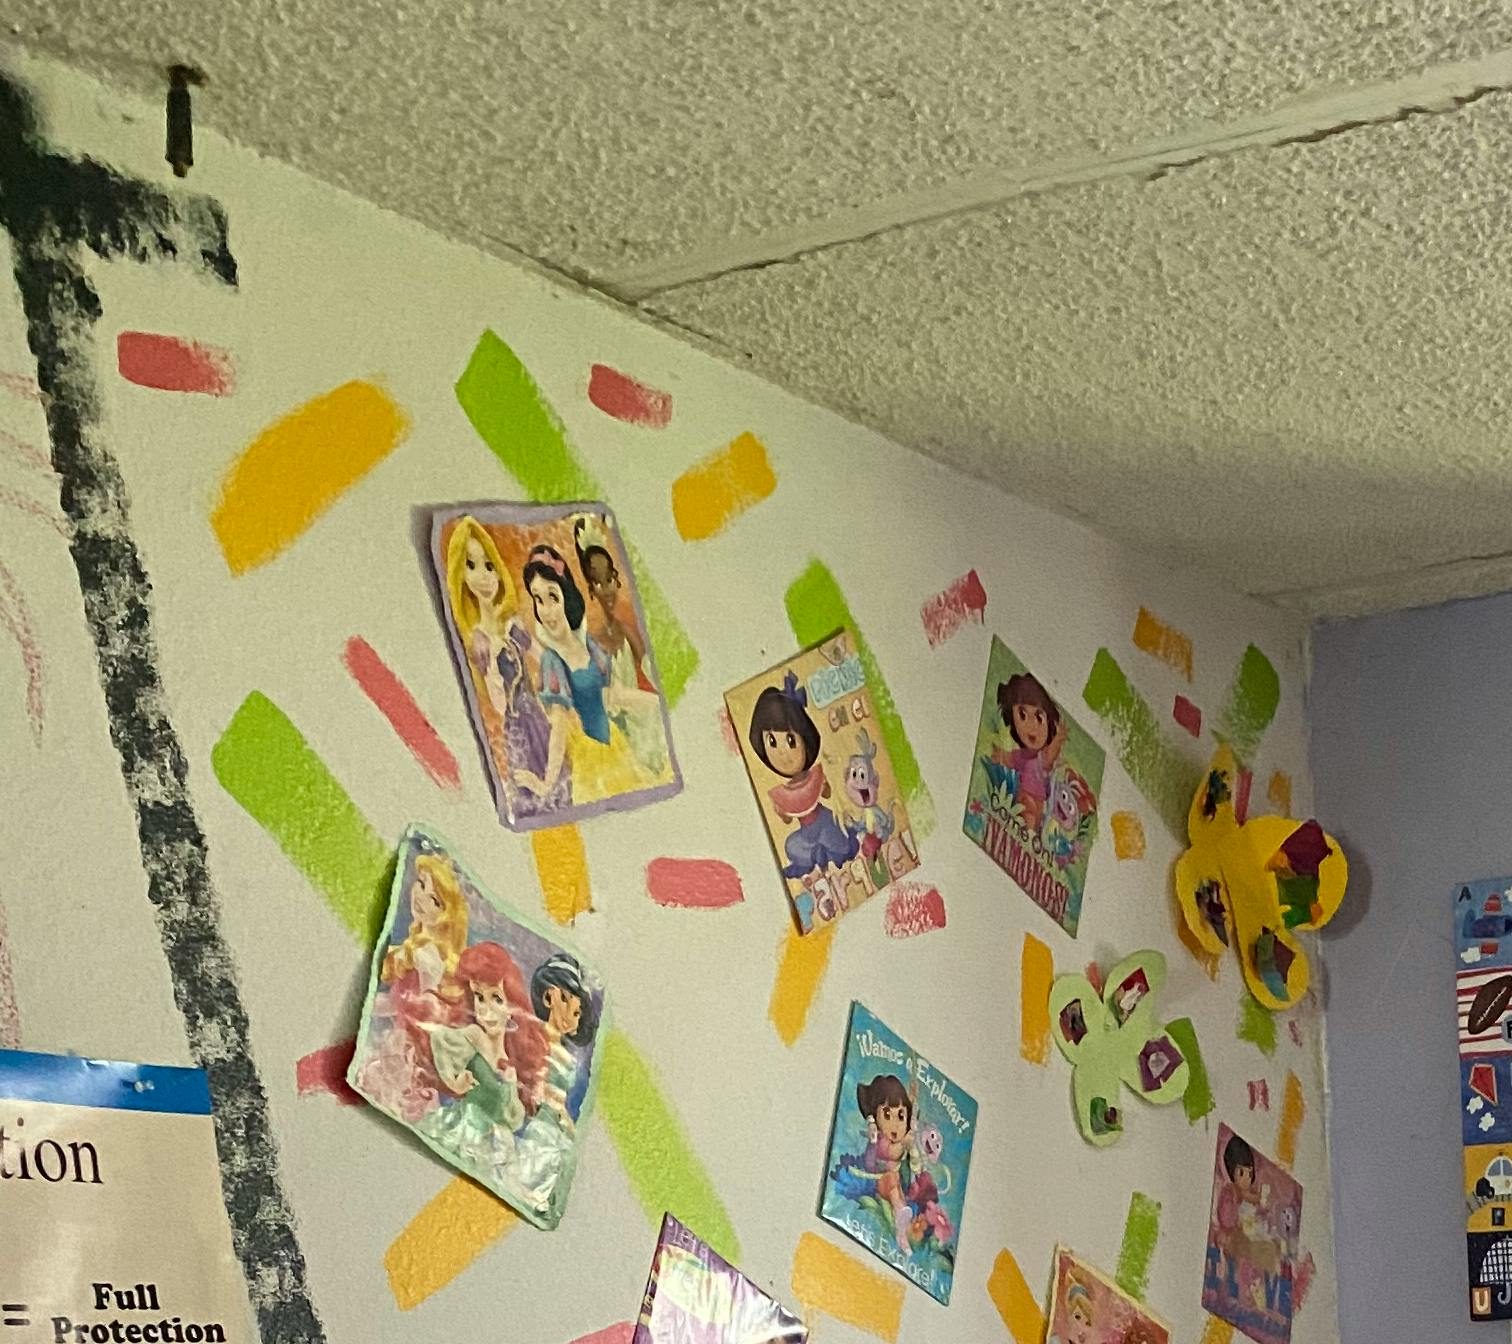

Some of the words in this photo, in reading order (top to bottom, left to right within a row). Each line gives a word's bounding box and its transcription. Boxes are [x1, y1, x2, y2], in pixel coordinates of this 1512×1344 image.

[991, 792, 1029, 842] Come
[1459, 886, 1471, 902] A
[917, 1058, 970, 1133] Explorar!
[880, 1237, 935, 1287] Explore!
[92, 1283, 160, 1310] Full
[1474, 1290, 1488, 1312] U
[51, 1317, 226, 1344] Protection
